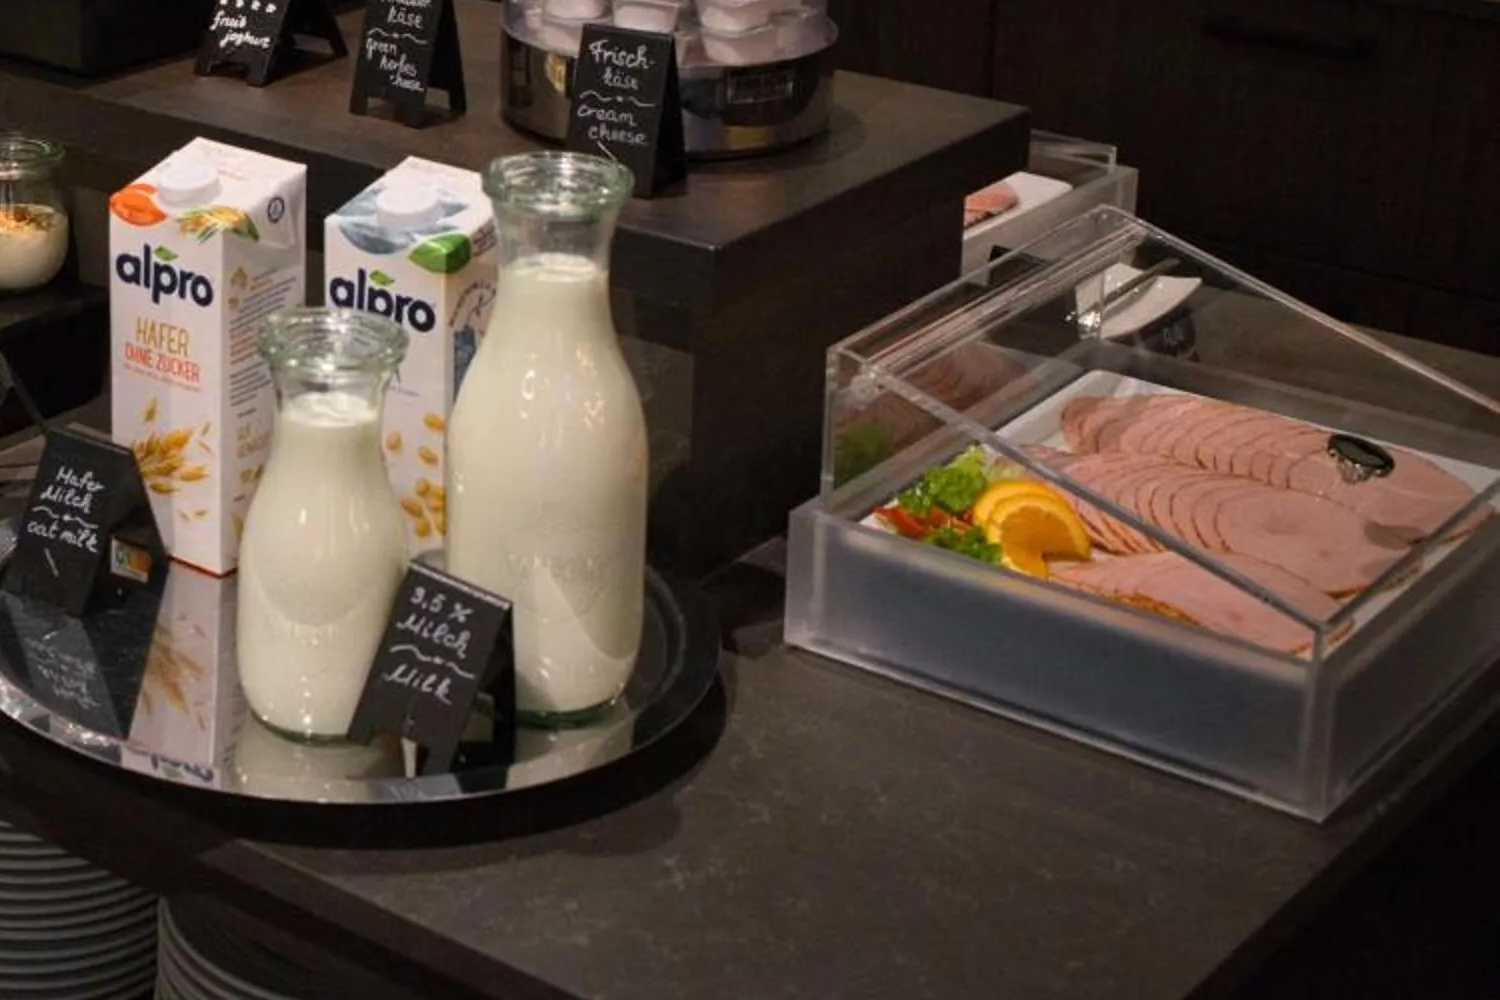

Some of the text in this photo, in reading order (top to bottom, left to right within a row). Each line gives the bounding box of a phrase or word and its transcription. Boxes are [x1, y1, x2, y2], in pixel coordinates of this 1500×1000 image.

[588, 123, 648, 147] cheese
[115, 243, 213, 307] alpro
[329, 267, 436, 333] alpro
[136, 315, 190, 357] HAFER
[124, 342, 154, 370] OHNE
[156, 351, 201, 384] ZUCKER
[395, 612, 472, 660] Milch
[382, 663, 453, 706] Milk
